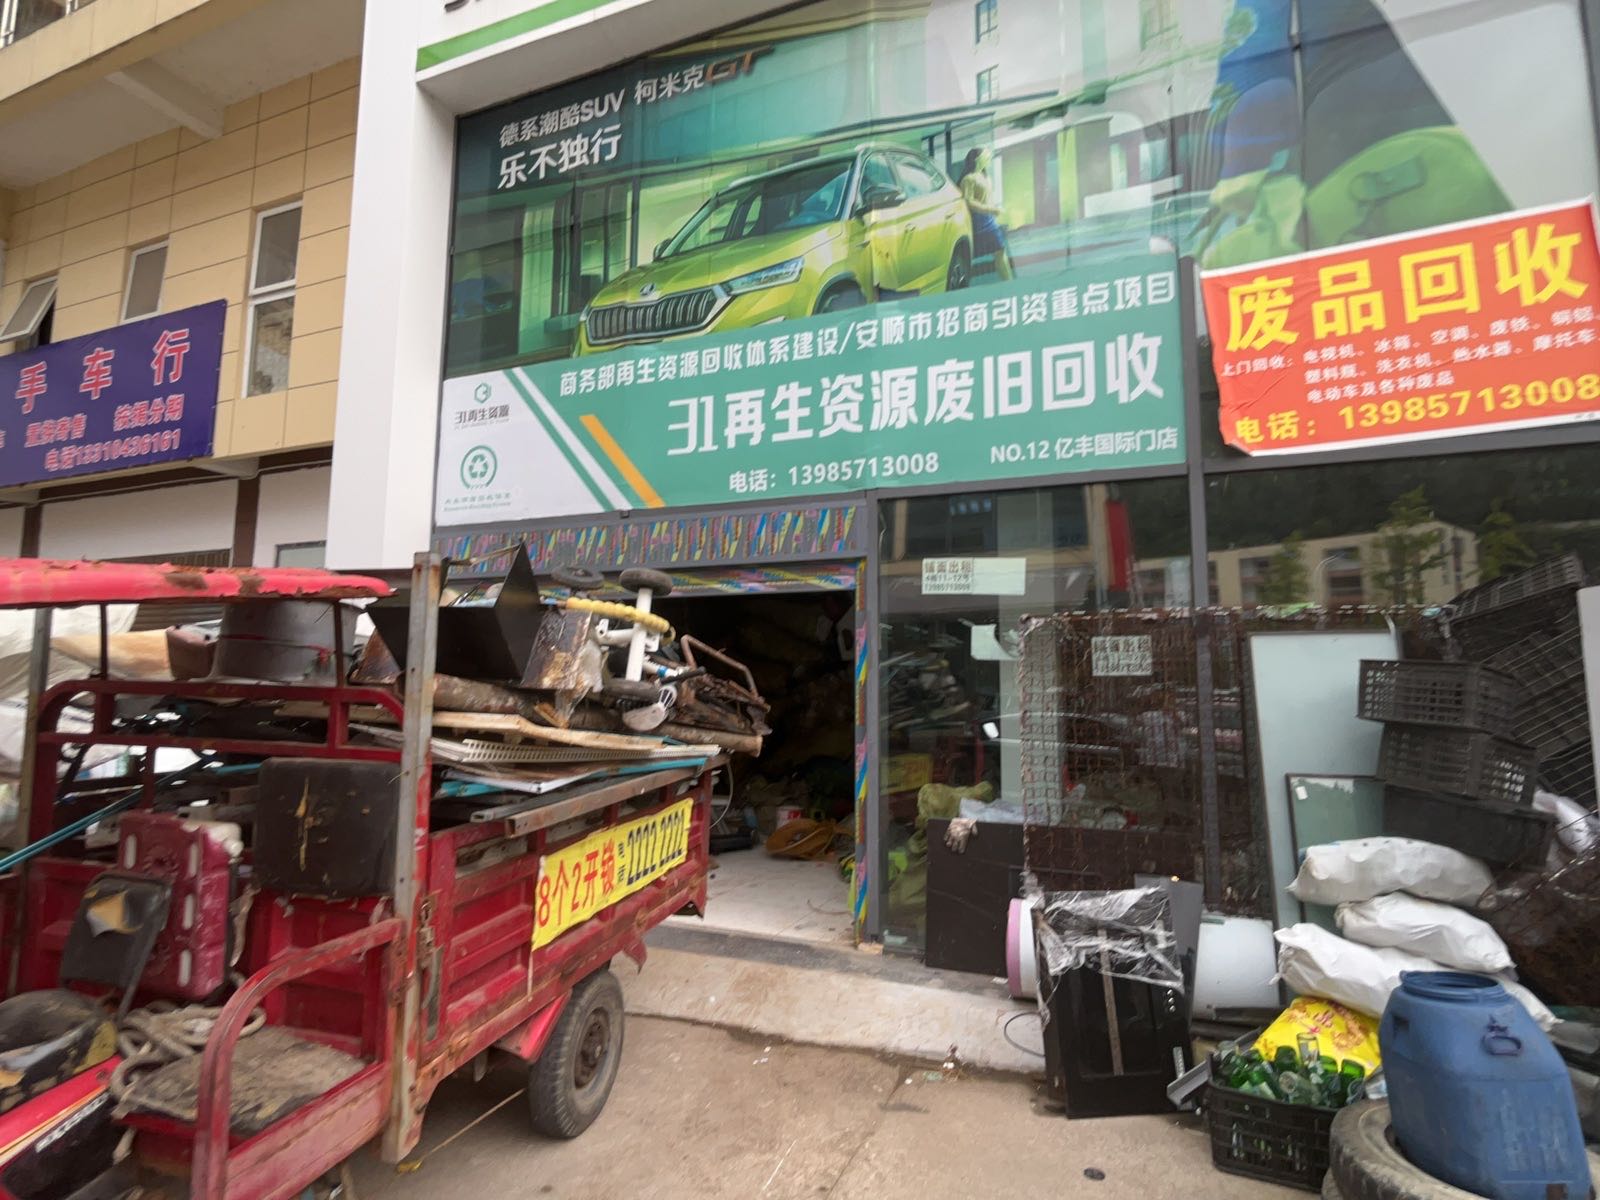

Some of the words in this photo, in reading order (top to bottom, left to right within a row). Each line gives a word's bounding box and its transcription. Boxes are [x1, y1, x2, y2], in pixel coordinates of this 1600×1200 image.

[499, 89, 625, 149] 德系潮酷SUV
[498, 124, 622, 190] 乐不独行
[1226, 222, 1589, 352] 废品回收
[1306, 370, 1454, 404] 电动车及各种废品
[538, 837, 615, 927] 8个2开锁
